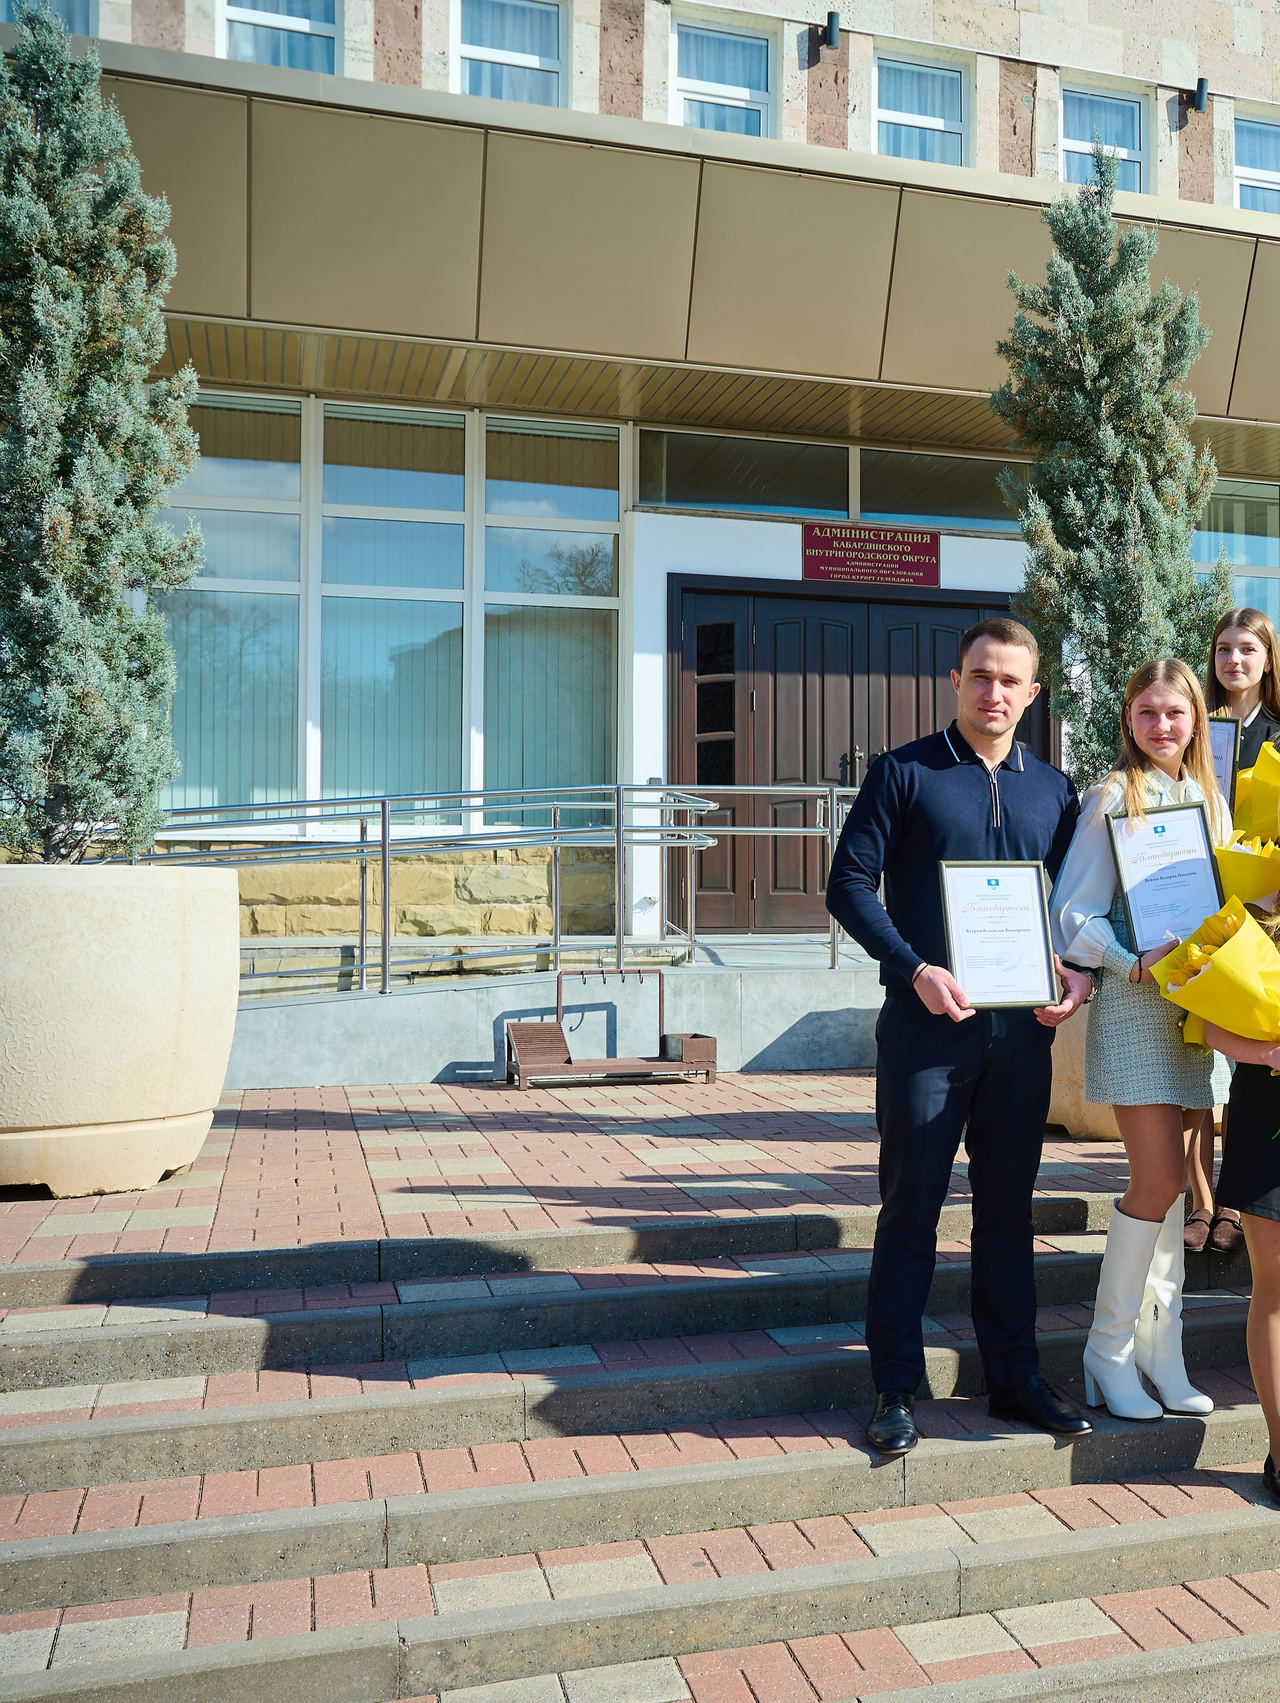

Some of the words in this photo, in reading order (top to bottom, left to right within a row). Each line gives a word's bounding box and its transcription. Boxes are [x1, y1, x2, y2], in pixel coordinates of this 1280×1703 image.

[812, 526, 931, 543] АДМИНИСТРАЦИЯ
[833, 540, 911, 552] КАБАРДИНСКОГО
[806, 548, 900, 561] ВНУТРИГОРОДСКОГО
[902, 554, 937, 564] ОКРУГА
[820, 565, 878, 574] МУНИЦИПАЛЬНОГО
[845, 560, 899, 568] АДМИНИСТРАЦИИ
[830, 573, 875, 581] ГОРОД-КУРОРТ
[1131, 848, 1197, 863] Благодарность
[961, 902, 1030, 914] Благодарность
